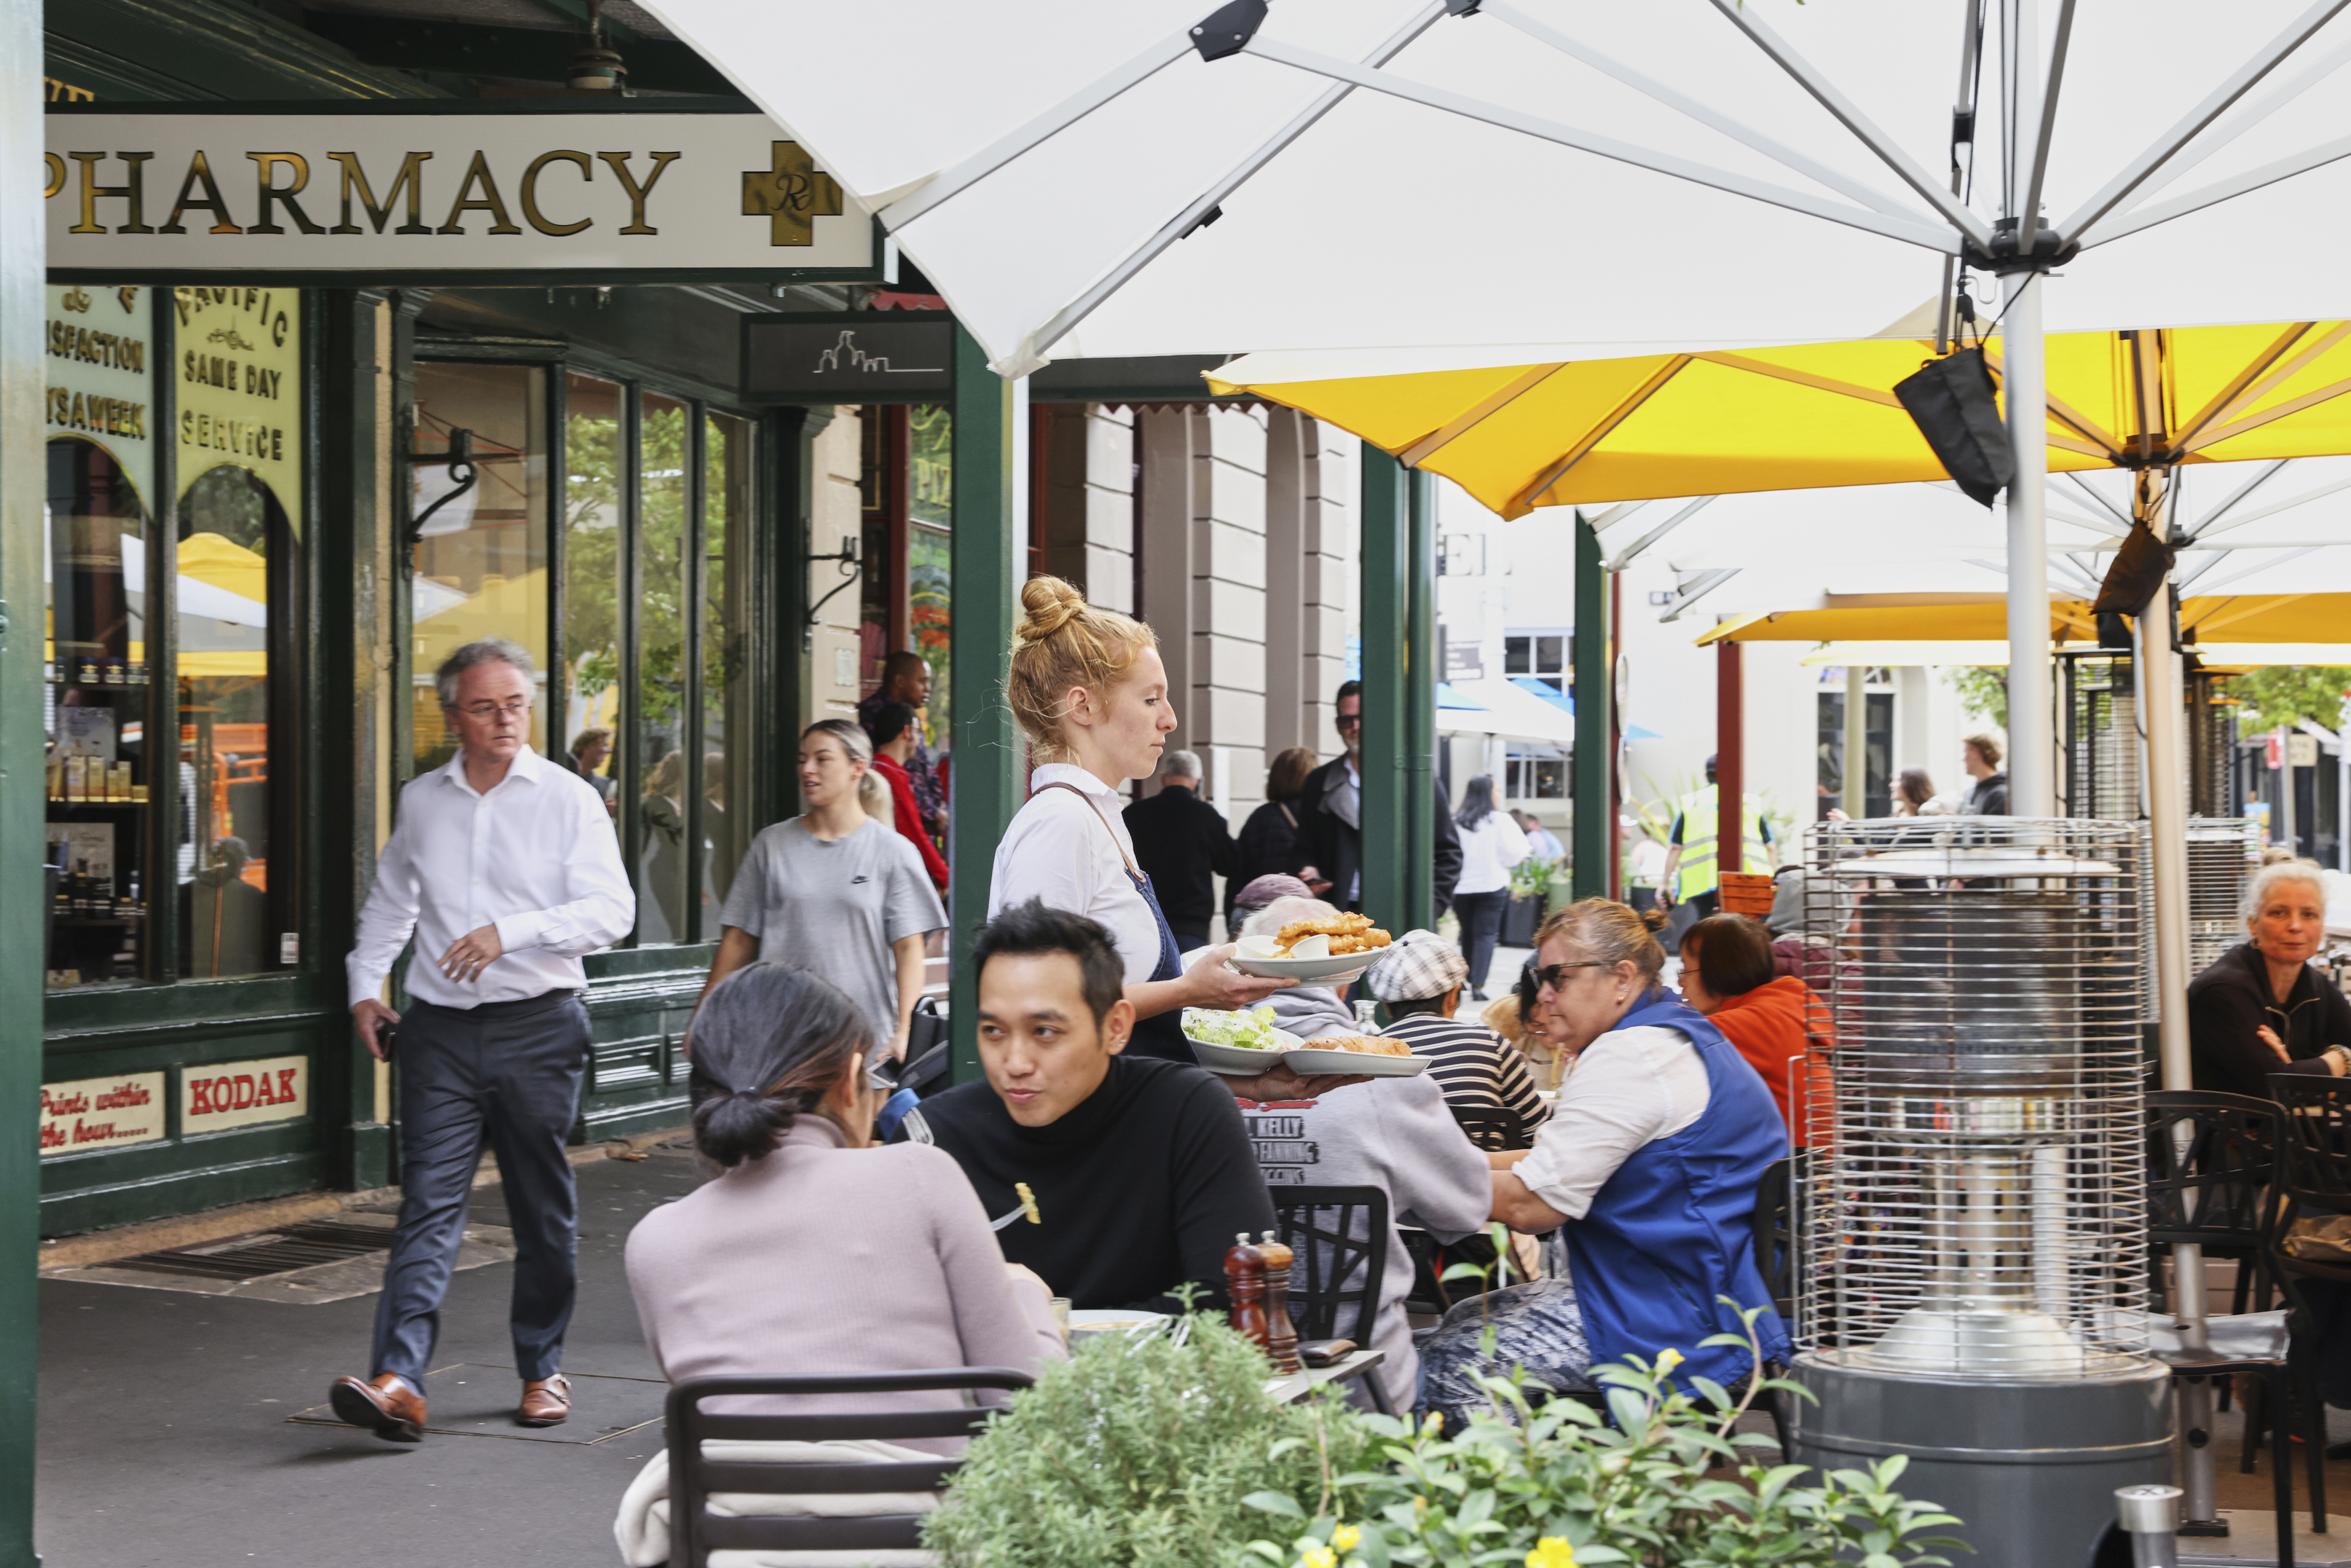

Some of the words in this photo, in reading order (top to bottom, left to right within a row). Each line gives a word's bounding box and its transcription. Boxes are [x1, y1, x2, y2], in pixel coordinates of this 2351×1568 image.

[184, 350, 237, 391] SAME
[245, 365, 282, 400] DAY
[181, 410, 283, 461] SERVICE
[190, 1068, 296, 1115] KODAK
